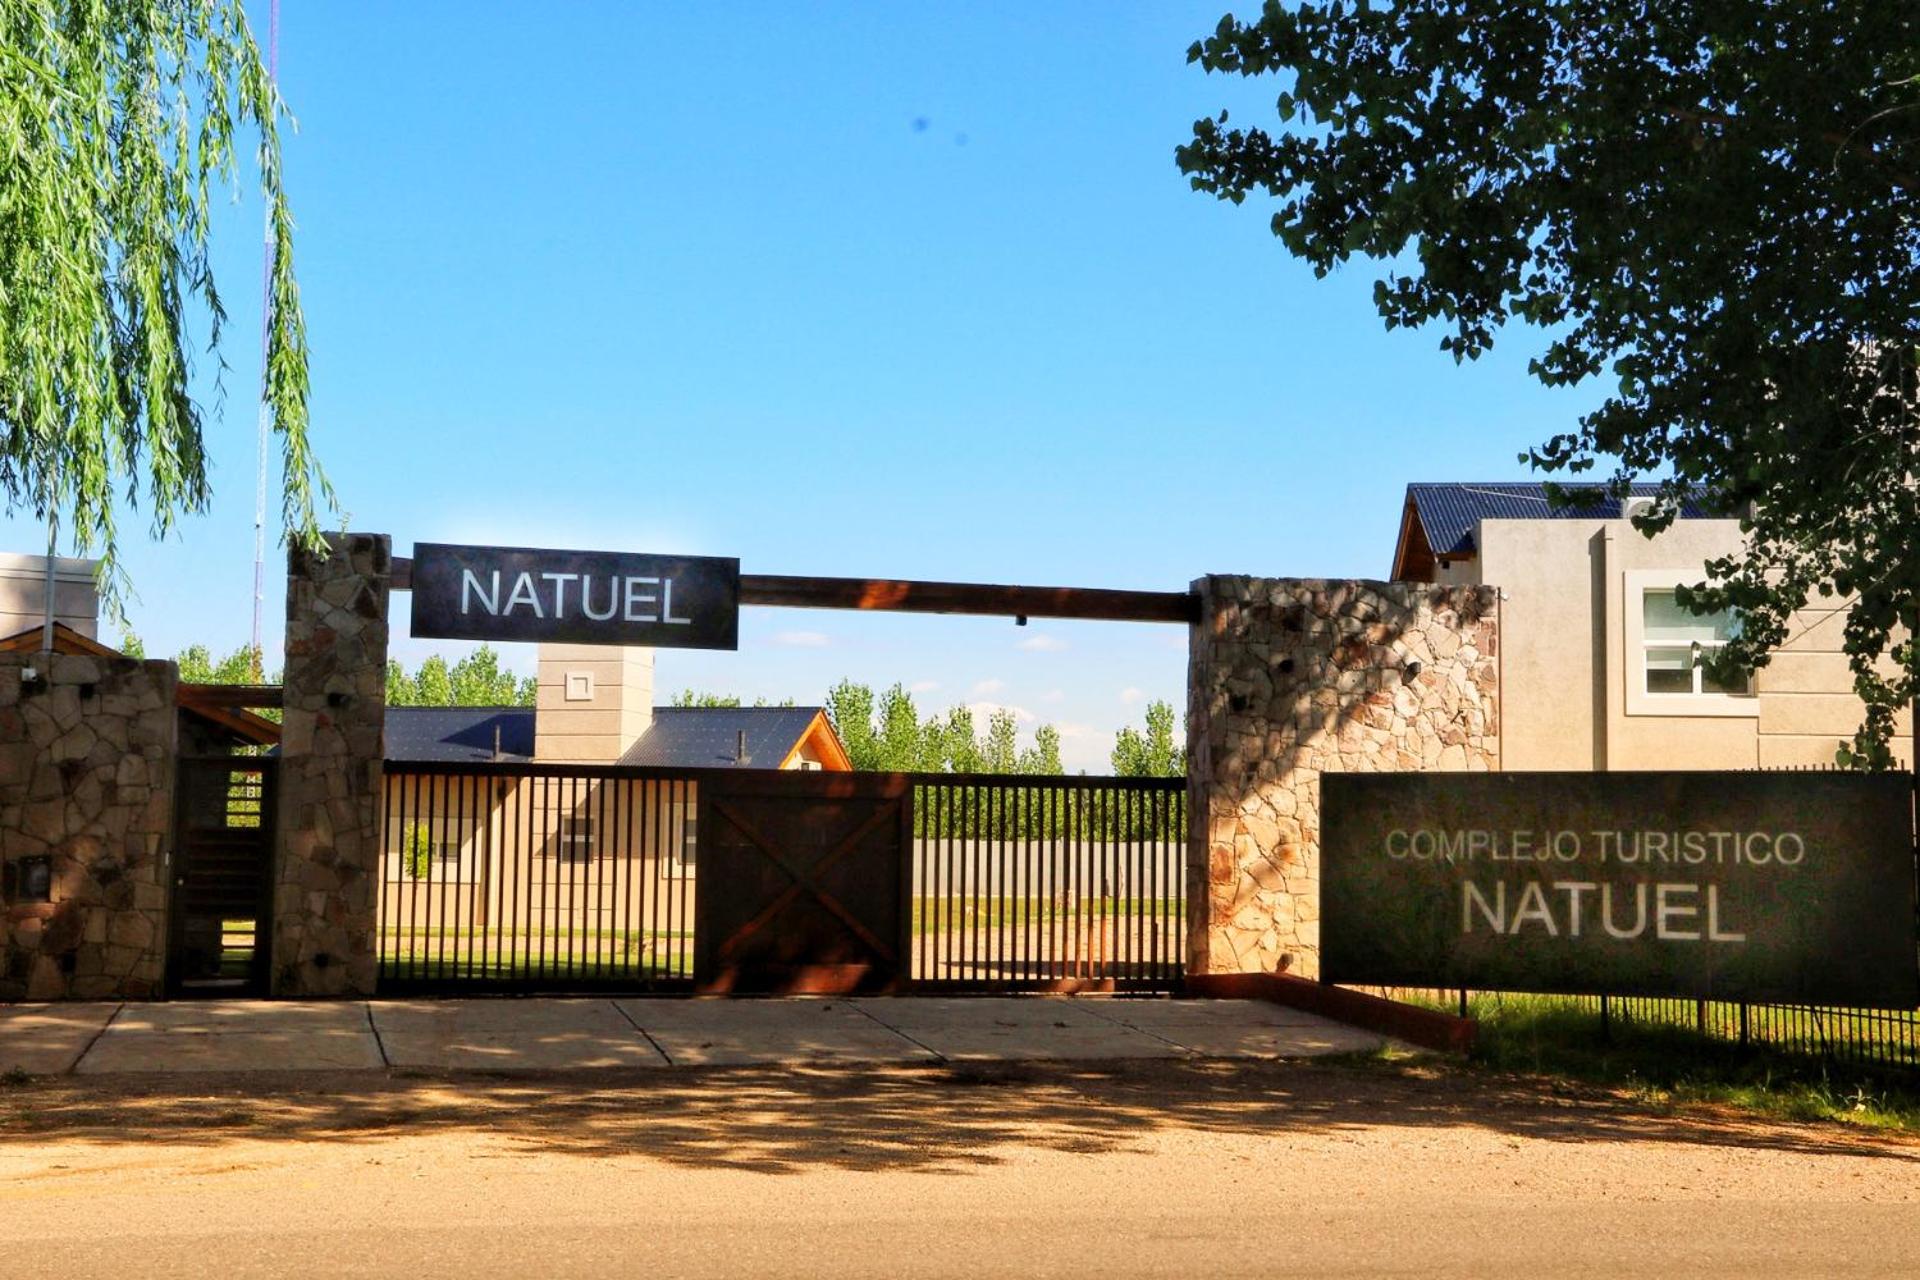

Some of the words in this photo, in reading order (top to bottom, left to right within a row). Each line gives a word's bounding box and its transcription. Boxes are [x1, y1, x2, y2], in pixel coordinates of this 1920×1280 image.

[461, 568, 691, 624] NATUEL
[1385, 829, 1582, 862] COMPLEJO
[1591, 830, 1805, 865] TURISTICO
[1463, 879, 1746, 942] NATUEL
